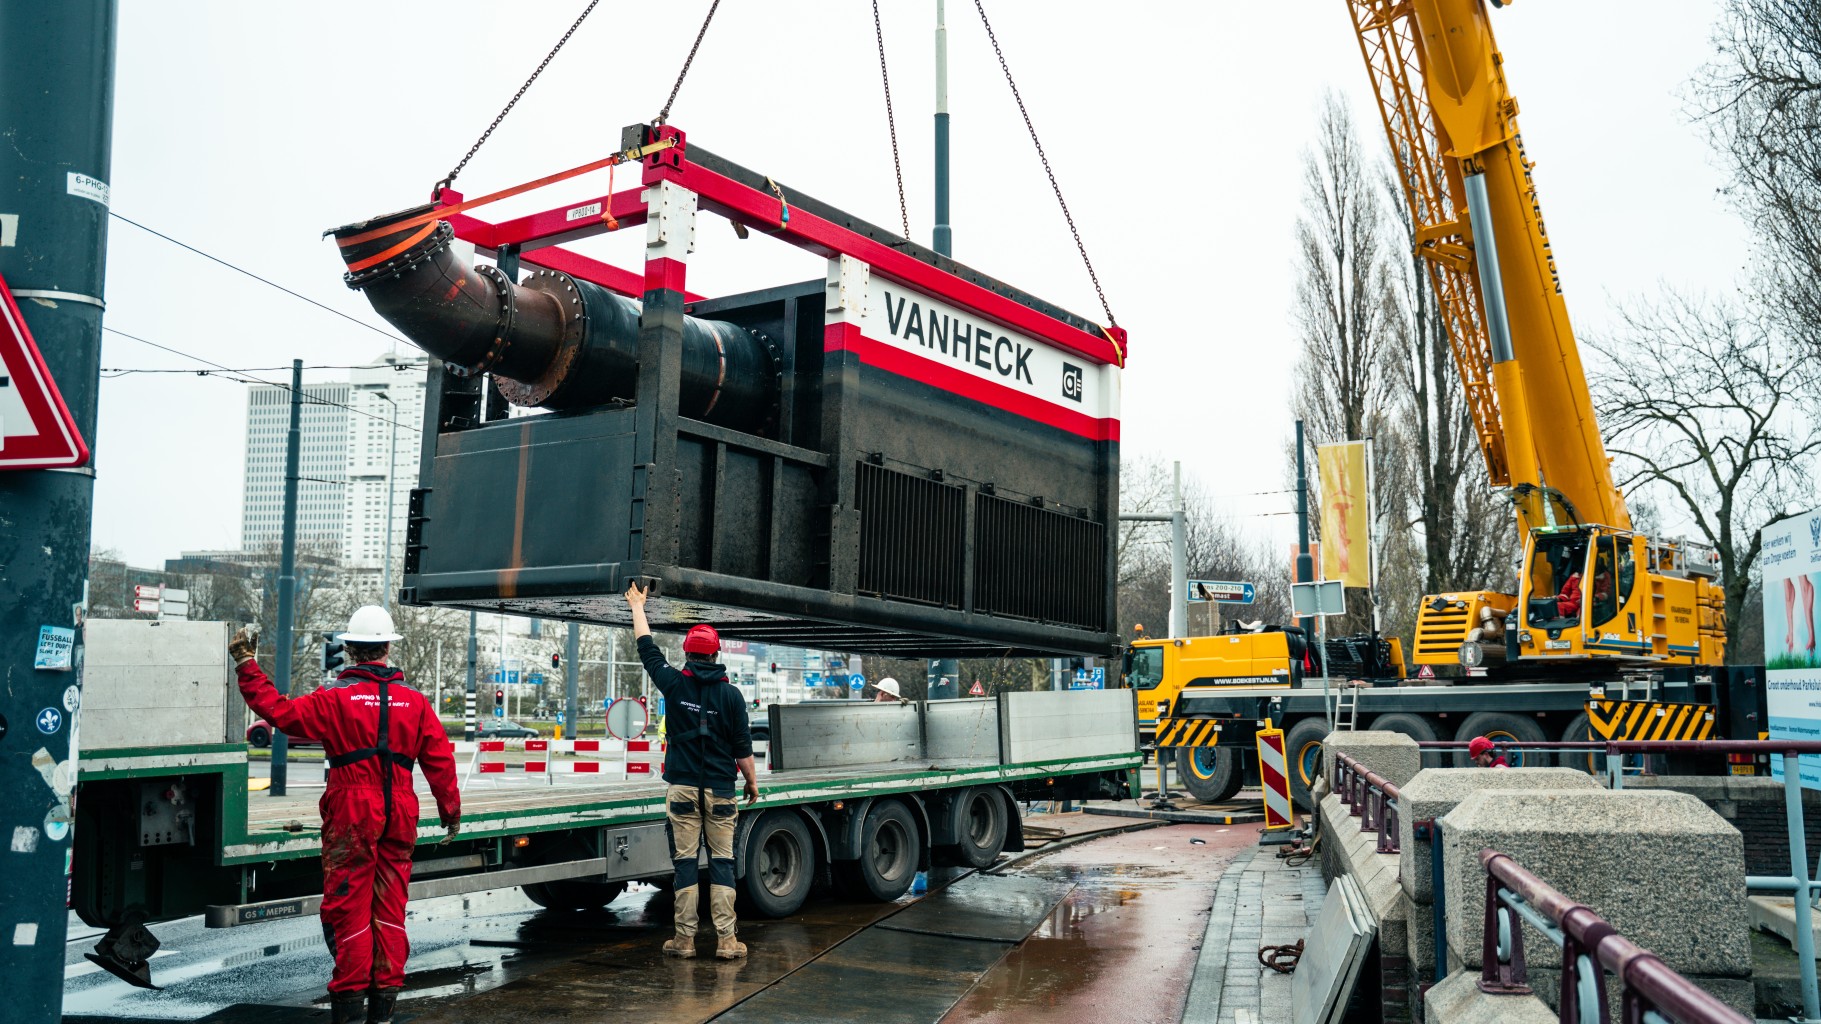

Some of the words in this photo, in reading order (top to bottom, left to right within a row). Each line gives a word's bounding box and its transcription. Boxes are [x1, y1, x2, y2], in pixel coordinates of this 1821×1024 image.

[884, 291, 1034, 385] VANHECK
[1213, 677, 1279, 685] WWW.BOEKESTIJN.NL
[244, 911, 257, 919] GS
[266, 905, 297, 916] MEPPEL
